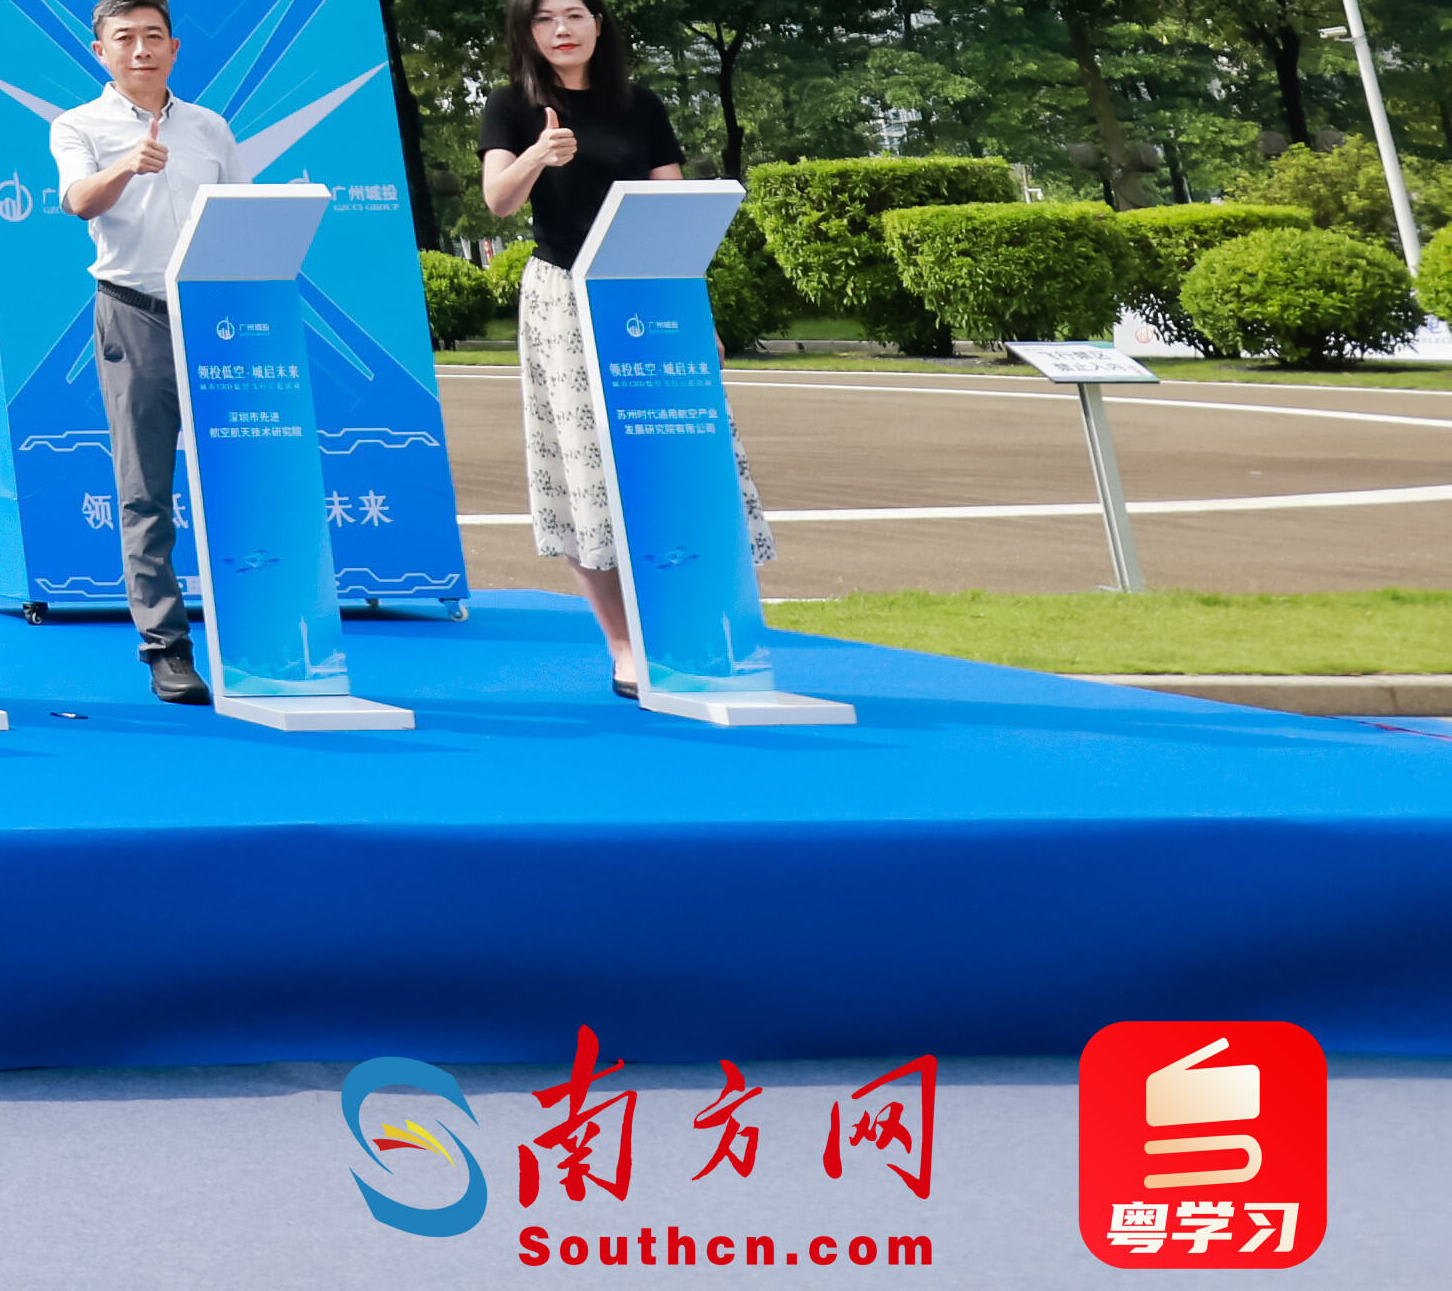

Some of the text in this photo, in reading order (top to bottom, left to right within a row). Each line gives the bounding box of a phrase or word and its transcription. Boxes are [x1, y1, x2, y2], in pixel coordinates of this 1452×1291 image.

[332, 184, 398, 201] 广州城投
[228, 411, 280, 423] 深圳市先进
[210, 426, 303, 438] 航空航天技术研究院
